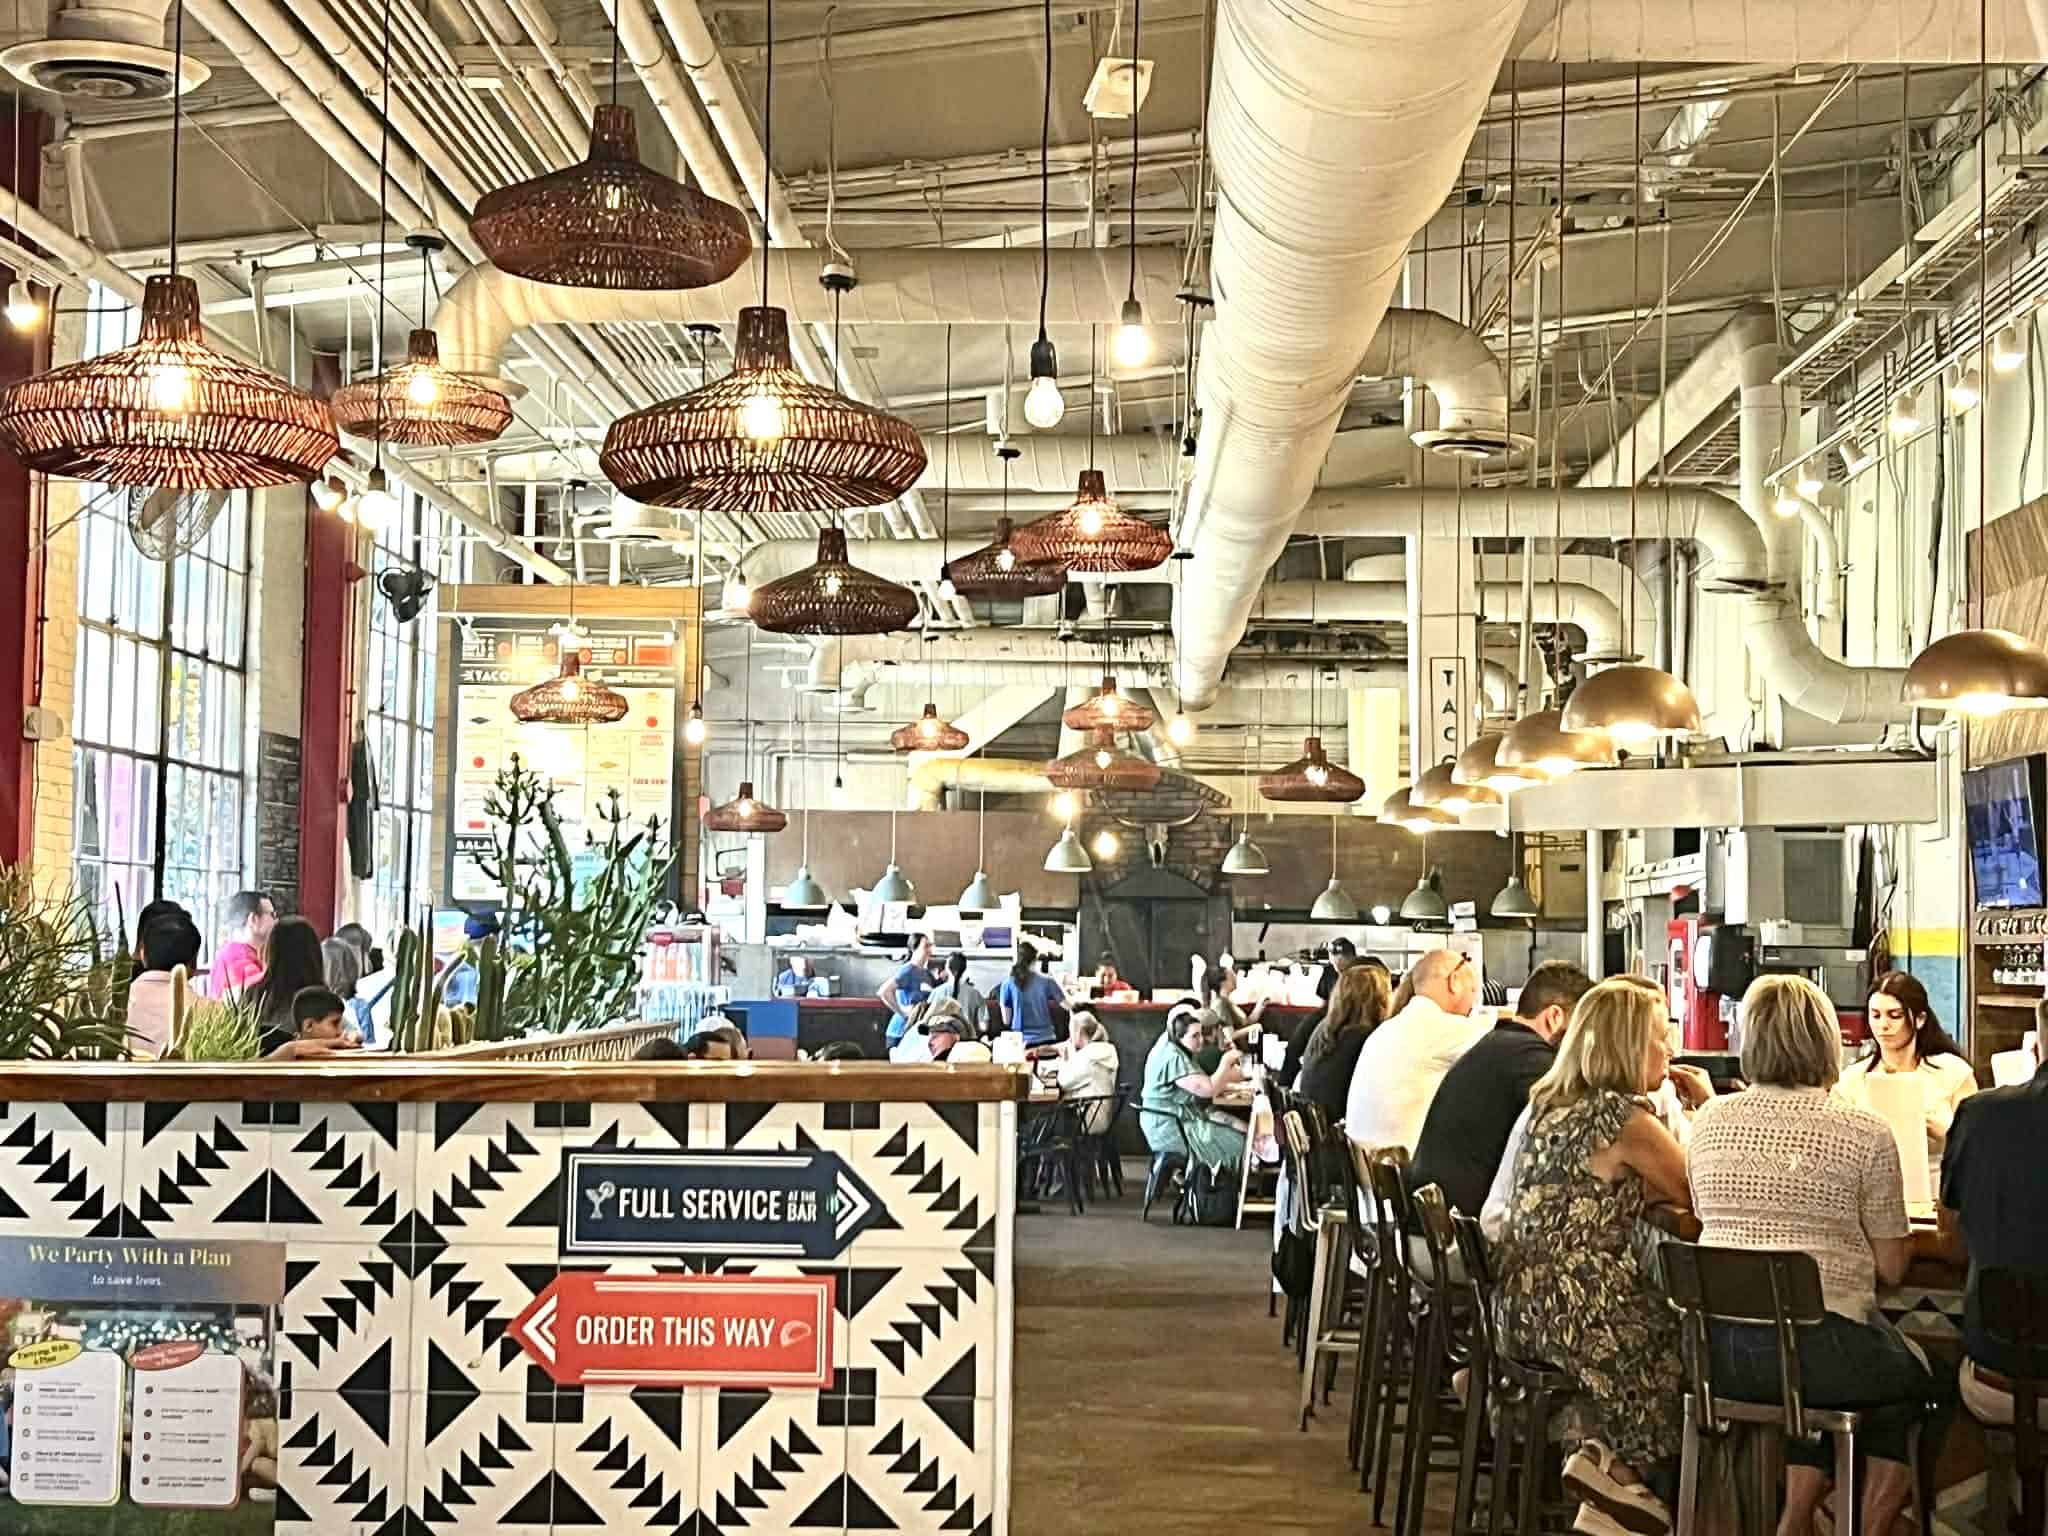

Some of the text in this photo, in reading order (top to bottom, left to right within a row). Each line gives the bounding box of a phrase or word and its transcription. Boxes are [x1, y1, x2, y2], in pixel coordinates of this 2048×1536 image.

[618, 1188, 674, 1219] FULL
[682, 1189, 781, 1221] SERVICE
[787, 1202, 817, 1222] BAR
[29, 1245, 231, 1269] We Party With a Plan
[576, 1316, 775, 1347] ORDER THIS WAY
